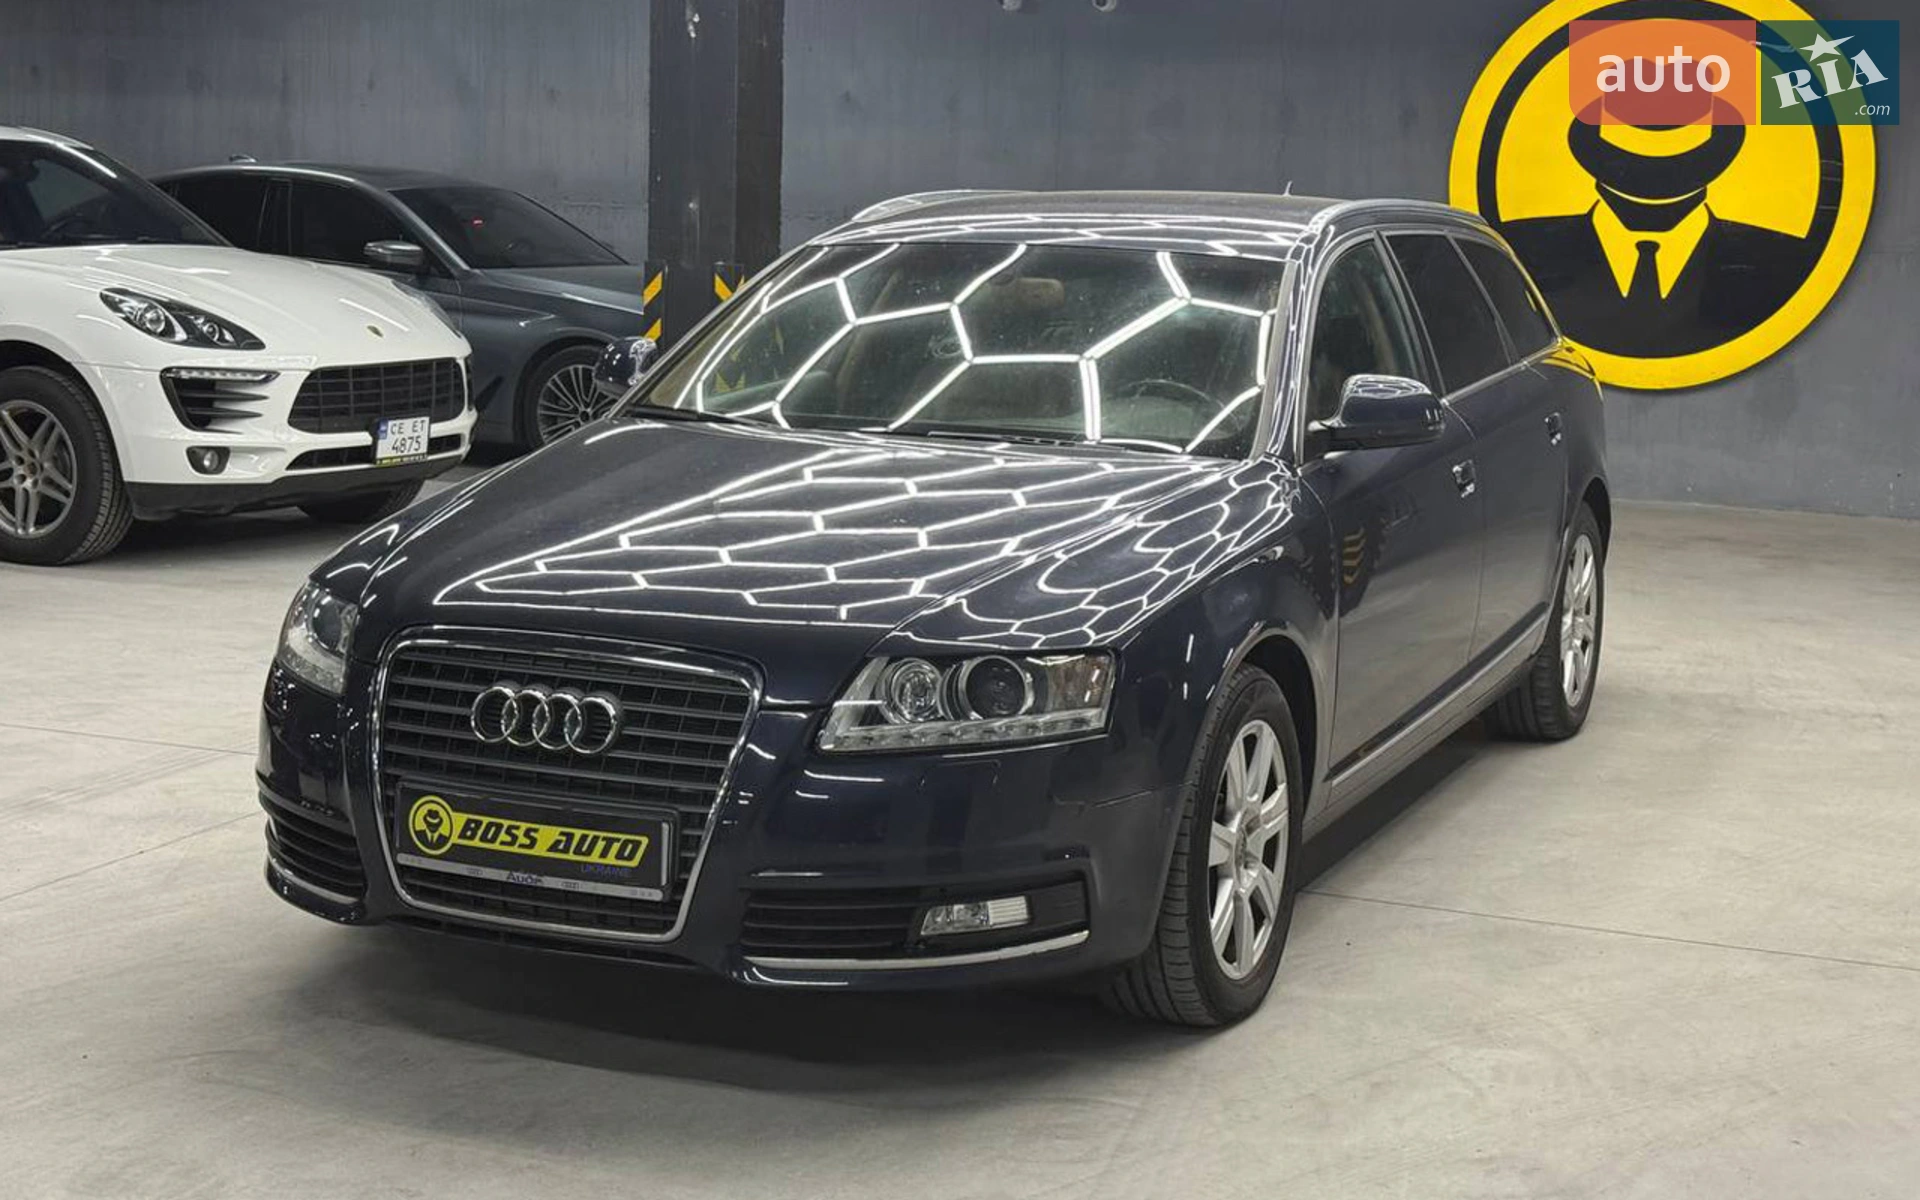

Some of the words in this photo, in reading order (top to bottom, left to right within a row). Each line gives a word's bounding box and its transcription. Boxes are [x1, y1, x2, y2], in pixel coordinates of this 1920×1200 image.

[392, 436, 421, 454] 4875
[458, 818, 540, 849] BOSS
[547, 831, 643, 862] AUTO
